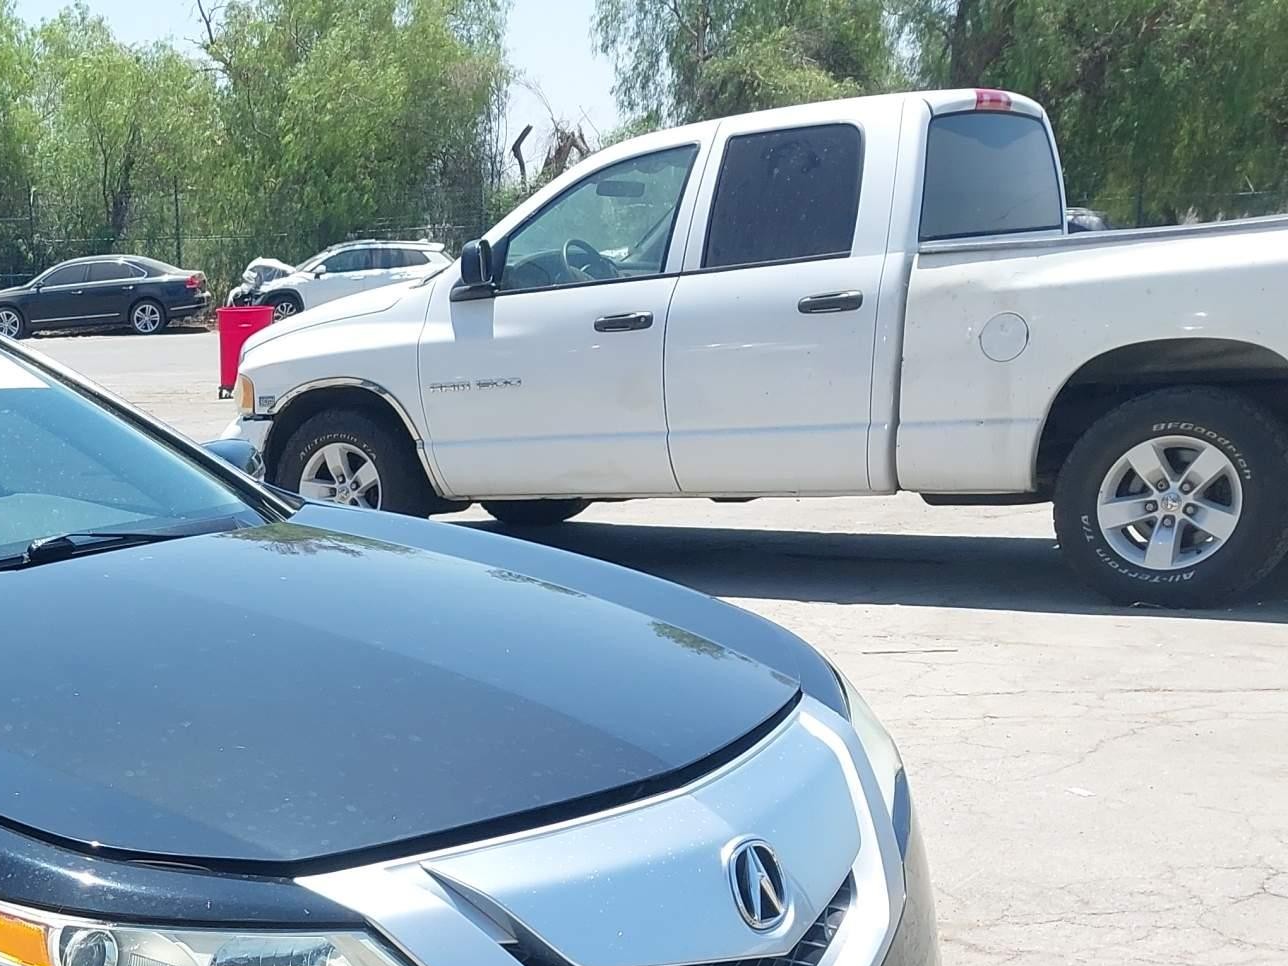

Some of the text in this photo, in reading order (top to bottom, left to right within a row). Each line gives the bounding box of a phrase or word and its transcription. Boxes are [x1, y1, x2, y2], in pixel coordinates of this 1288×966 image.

[1152, 422, 1252, 480] BFGoodrich
[1081, 514, 1197, 583] All-Terrain T/A
